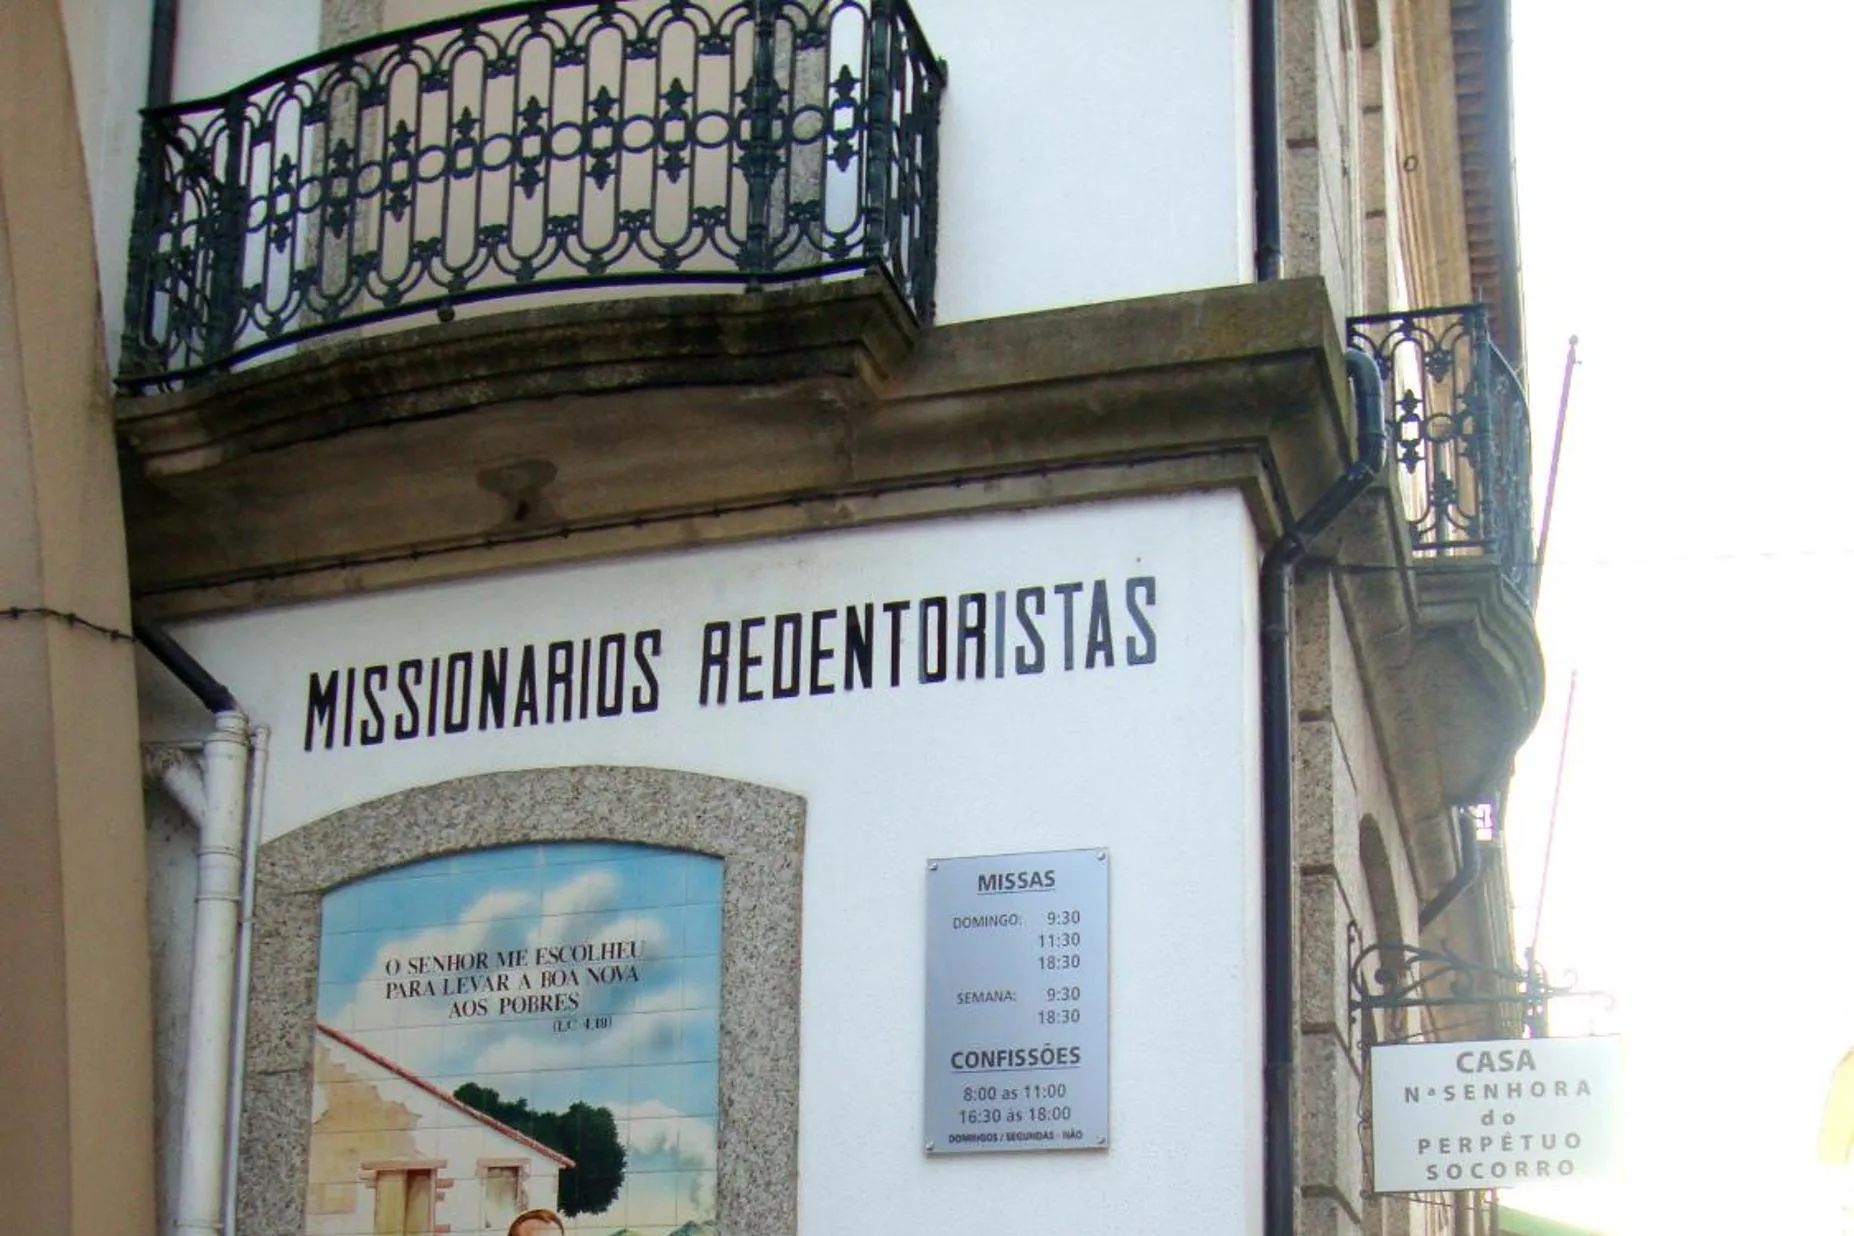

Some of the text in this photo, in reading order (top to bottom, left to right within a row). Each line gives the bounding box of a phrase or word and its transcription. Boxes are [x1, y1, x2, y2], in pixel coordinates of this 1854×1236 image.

[303, 575, 1157, 753] MISSIONARIOS REDENTORISTAS
[976, 869, 1056, 892] MISSAS
[952, 910, 1081, 930] DOMINGO: 9:30
[1038, 932, 1081, 949] 11:30
[385, 939, 646, 977] O SENHOR ME ESCOLHEU
[1038, 954, 1081, 970] 18:30
[386, 963, 640, 999] PARA LEVAR A BOA NOVA
[448, 992, 580, 1019] AOS POBRES
[956, 986, 1081, 1005] SEMANA: 9:30
[1038, 1009, 1081, 1025] 18:30
[950, 1043, 1081, 1070] CONFISSÕES
[1456, 1049, 1536, 1074] CASA
[963, 1086, 997, 1102] 8:00
[1024, 1084, 1067, 1100] 11:00
[1443, 1080, 1592, 1103] SENHORA
[959, 1108, 1002, 1125] 16:30
[1029, 1105, 1072, 1121] 18:00
[1480, 1109, 1516, 1126] do
[948, 1132, 999, 1144] DOMINGOS
[1006, 1130, 1055, 1142] SEGUNDAS
[1062, 1128, 1084, 1140] NÃO
[1426, 1160, 1575, 1181] SOCORRO
